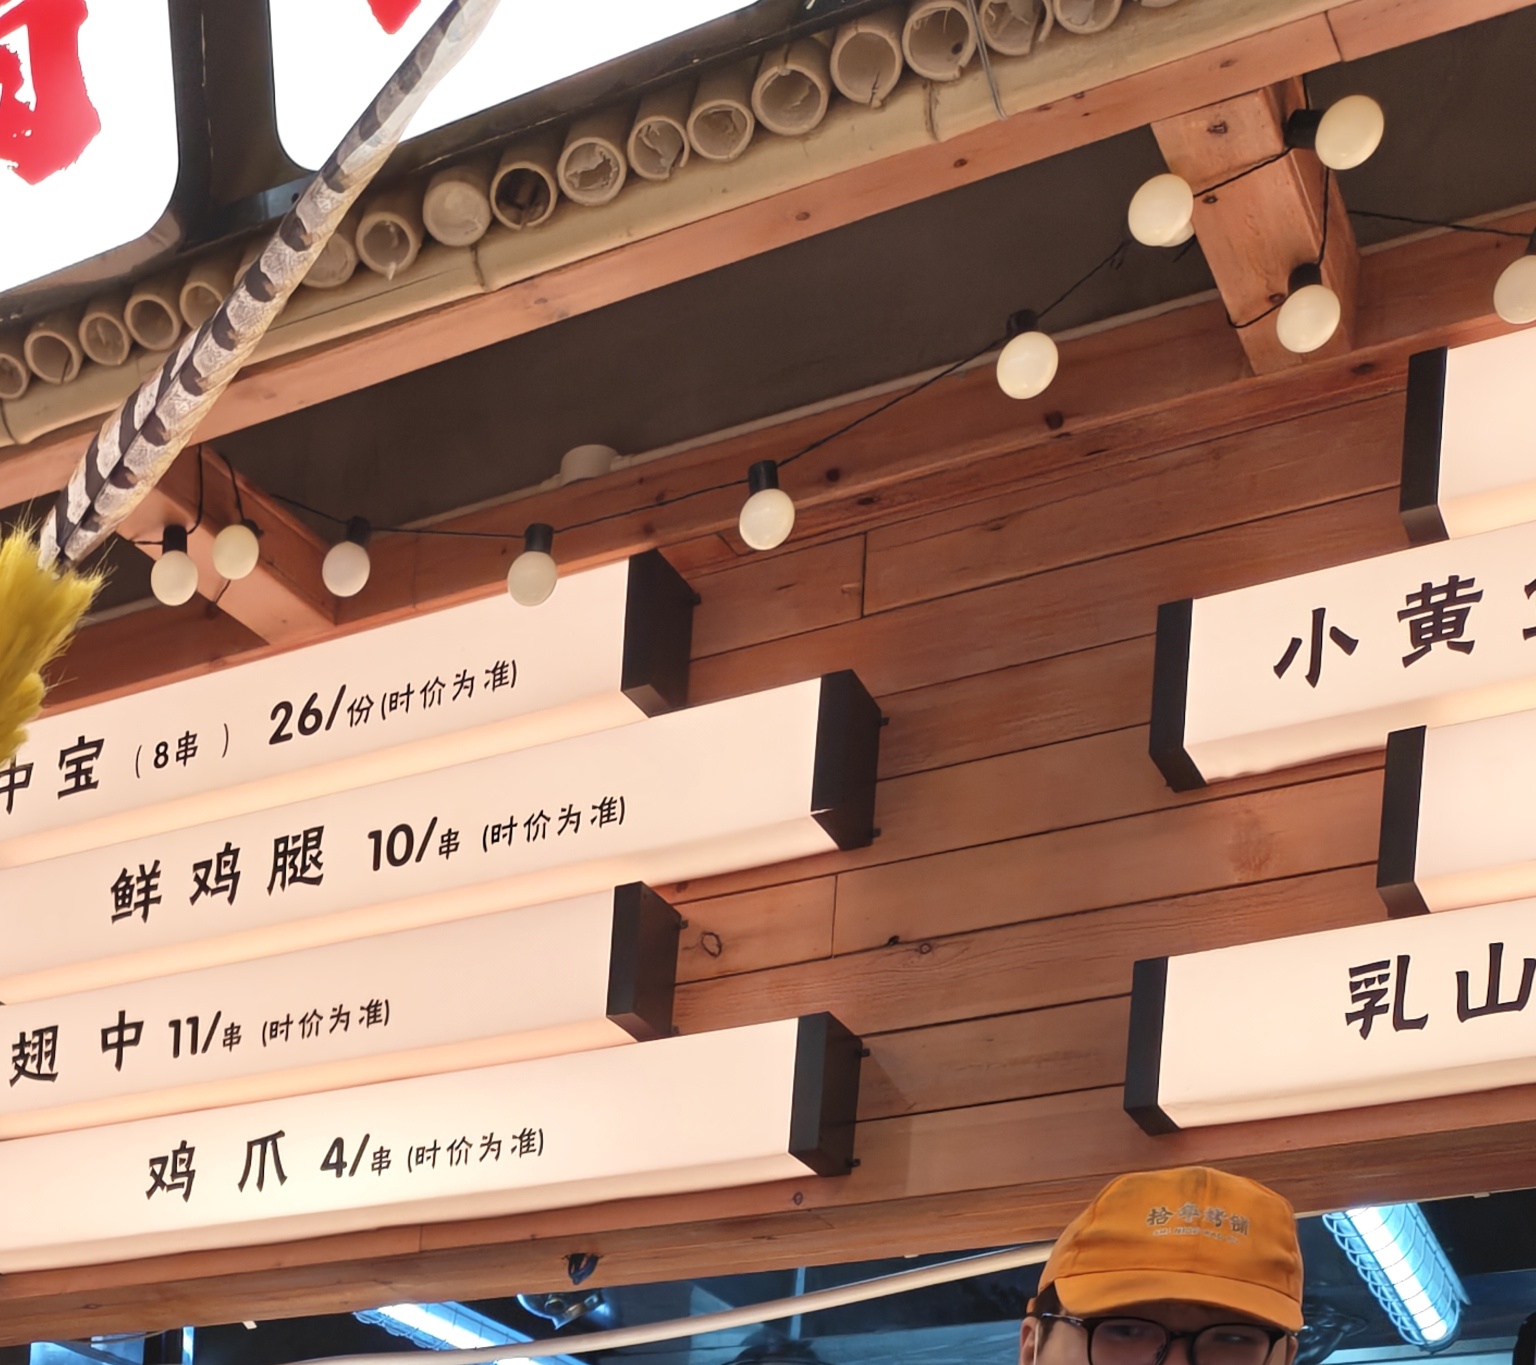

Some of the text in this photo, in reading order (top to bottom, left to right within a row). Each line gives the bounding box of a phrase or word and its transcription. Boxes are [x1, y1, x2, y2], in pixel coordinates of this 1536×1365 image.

[1273, 574, 1536, 688] 小黄
[111, 794, 627, 926] 鲜鸡腿 10/串 (时价为准)
[1345, 940, 1536, 1040] 乳山
[8, 998, 390, 1087] 翅中 11/串 (时价为准)
[146, 1127, 545, 1202] 鸡爪 4/串 (时价为准)
